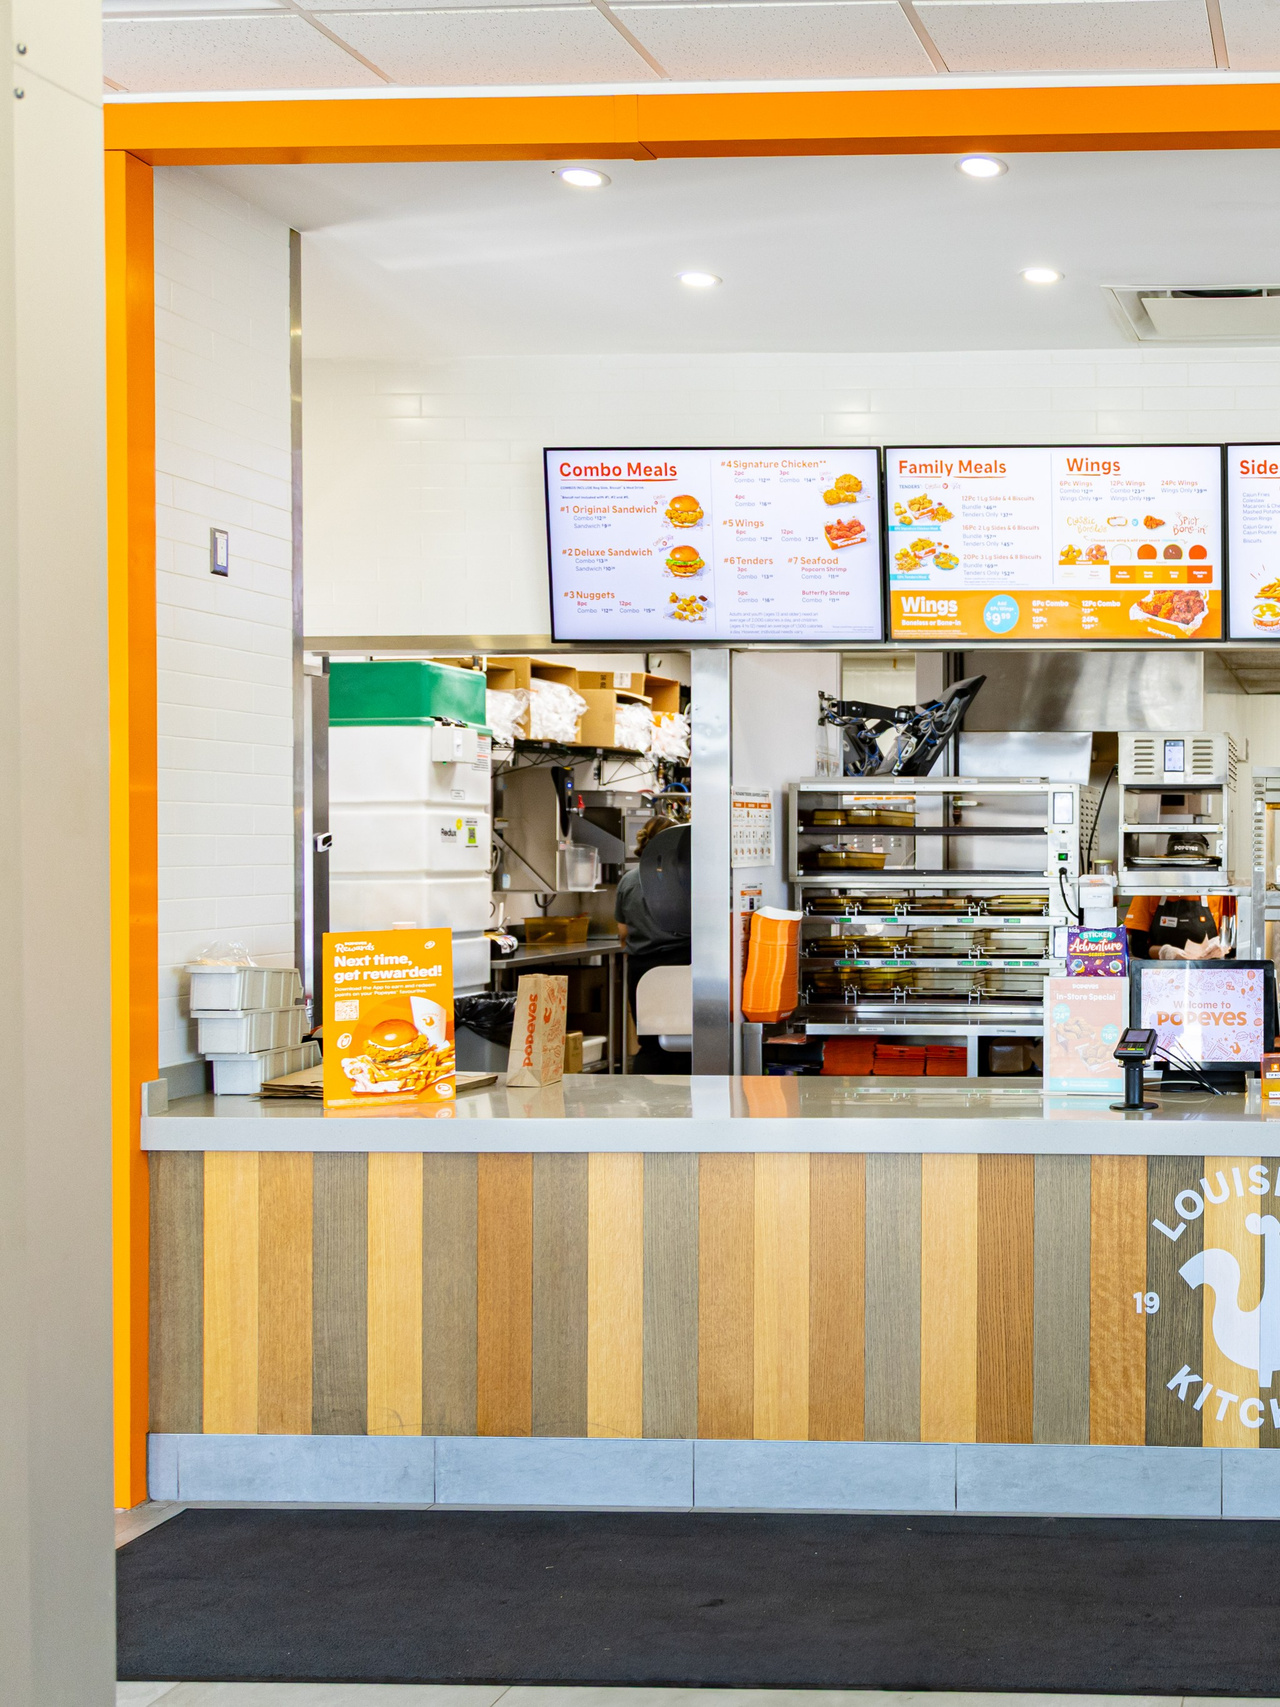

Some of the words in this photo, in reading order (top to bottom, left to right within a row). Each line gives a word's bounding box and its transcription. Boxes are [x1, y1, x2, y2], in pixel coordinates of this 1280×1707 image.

[560, 462, 622, 477] Combo
[627, 462, 678, 477] Meals
[733, 460, 779, 469] Signature
[899, 460, 953, 476] Family
[958, 460, 1007, 474] Meals
[1066, 458, 1120, 475] Wings
[573, 506, 610, 515] Original
[612, 506, 657, 514] Sandwich
[735, 519, 764, 528] Wings
[800, 557, 839, 565] Seafood
[576, 591, 615, 600] Nuggets
[901, 596, 958, 616] Wings
[441, 828, 456, 837] Redux
[335, 942, 375, 953] Rewards
[1069, 938, 1122, 952] Adventure
[334, 955, 371, 967] Next
[373, 954, 412, 966] time,
[334, 970, 360, 984] get
[364, 965, 442, 980] rewarded!
[1157, 1011, 1247, 1026] POPEYES
[1133, 1292, 1160, 1314] 19
